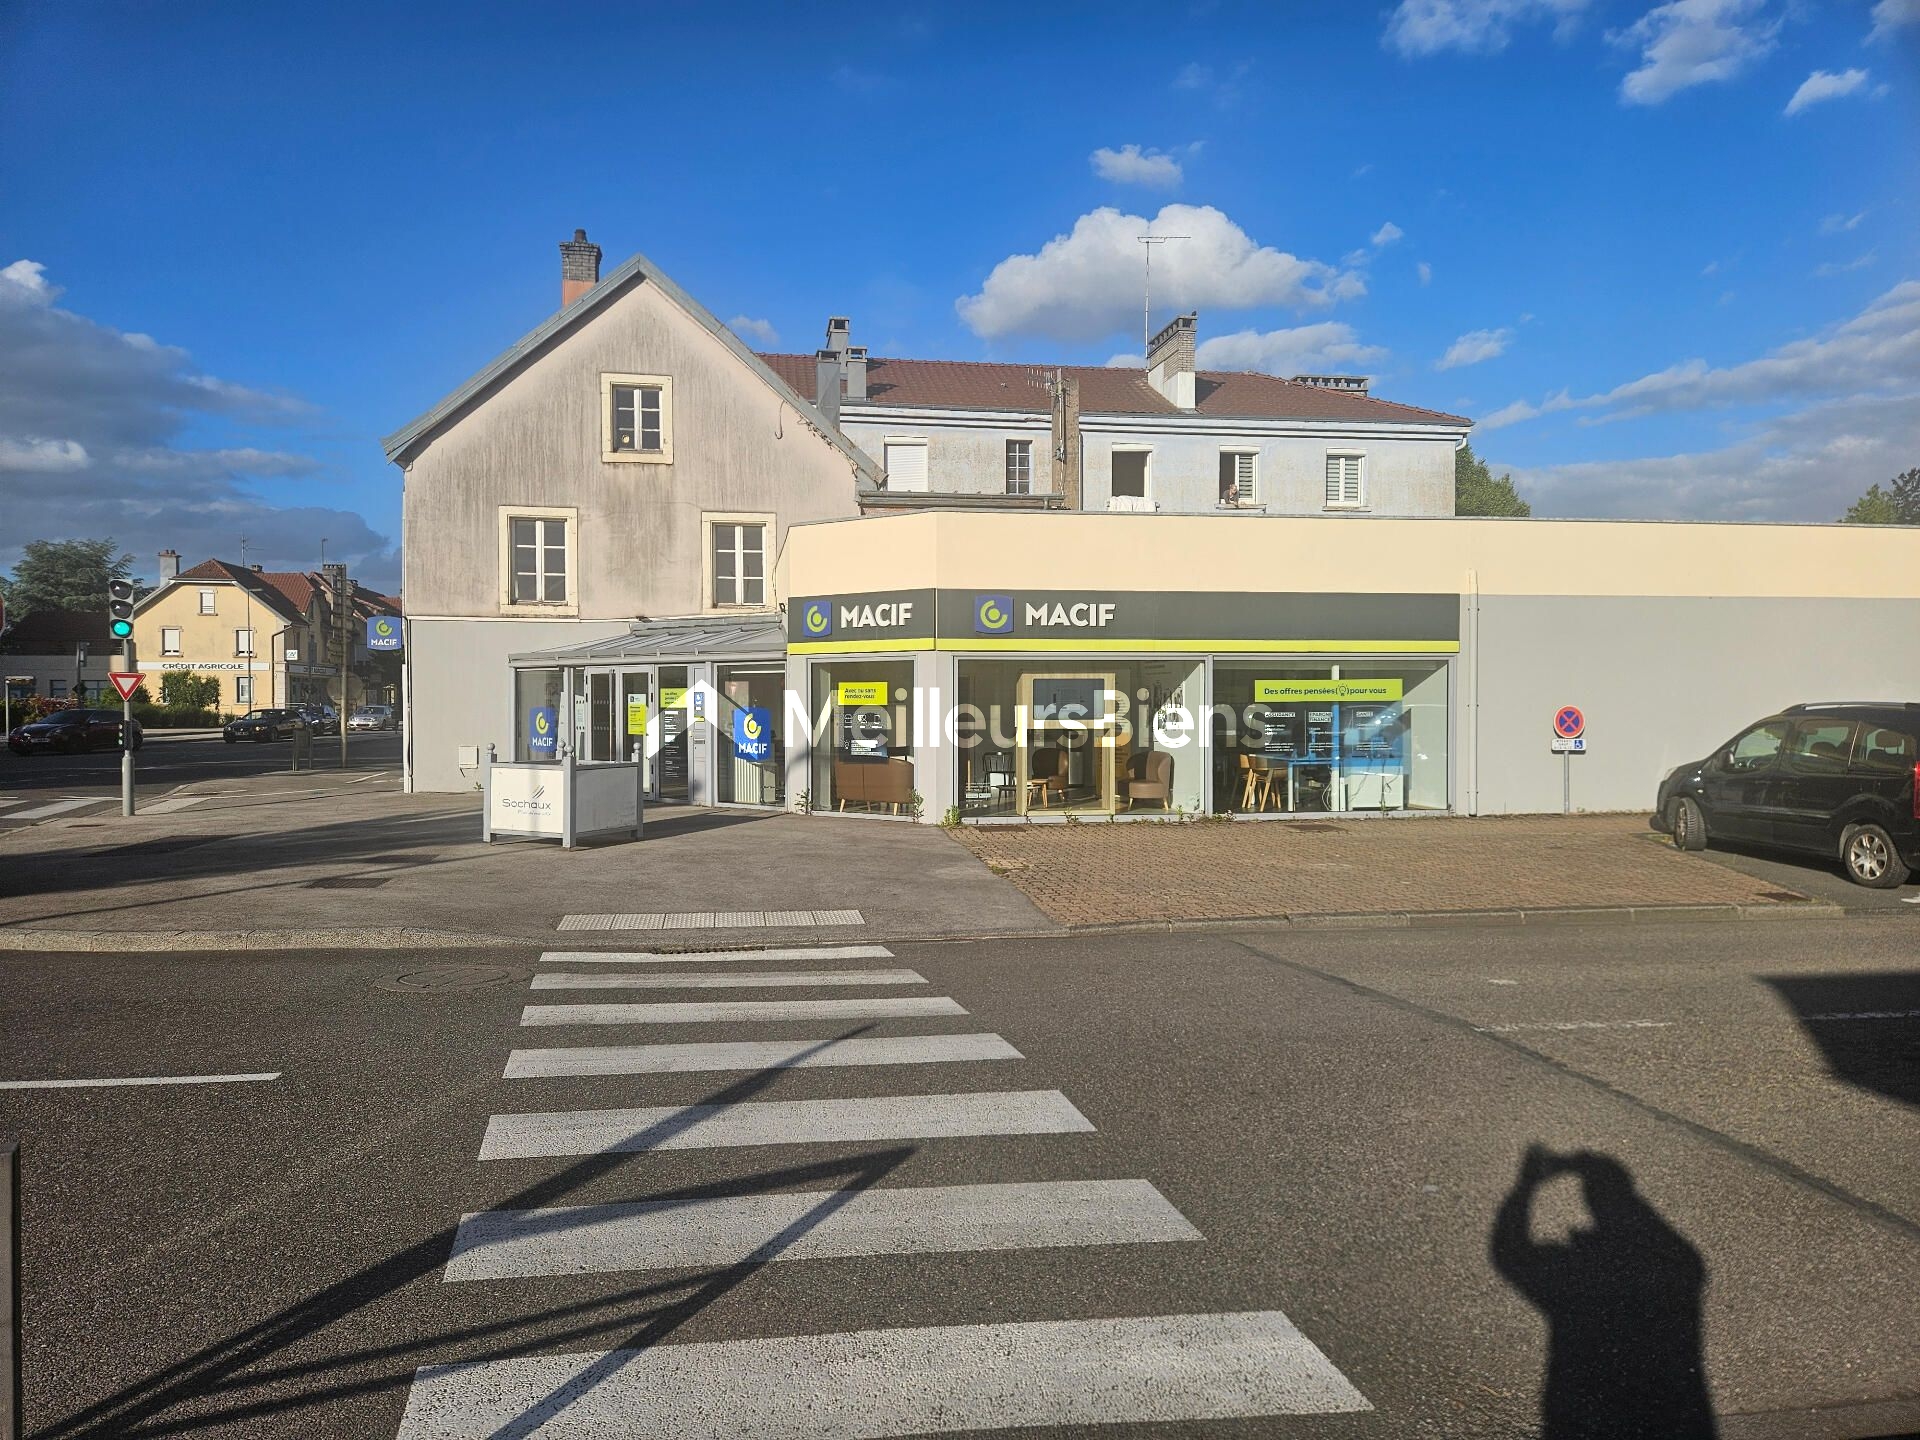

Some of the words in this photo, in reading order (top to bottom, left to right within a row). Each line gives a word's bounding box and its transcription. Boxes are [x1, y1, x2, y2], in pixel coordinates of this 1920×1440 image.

[840, 602, 913, 629] MACIF
[1025, 602, 1116, 628] MACIF
[370, 637, 398, 647] MACIF
[162, 662, 197, 670] CRÉDIT
[1279, 687, 1303, 695] offres
[532, 737, 553, 747] MACIF
[738, 742, 767, 755] MACIF
[502, 798, 552, 810] Sochaux
